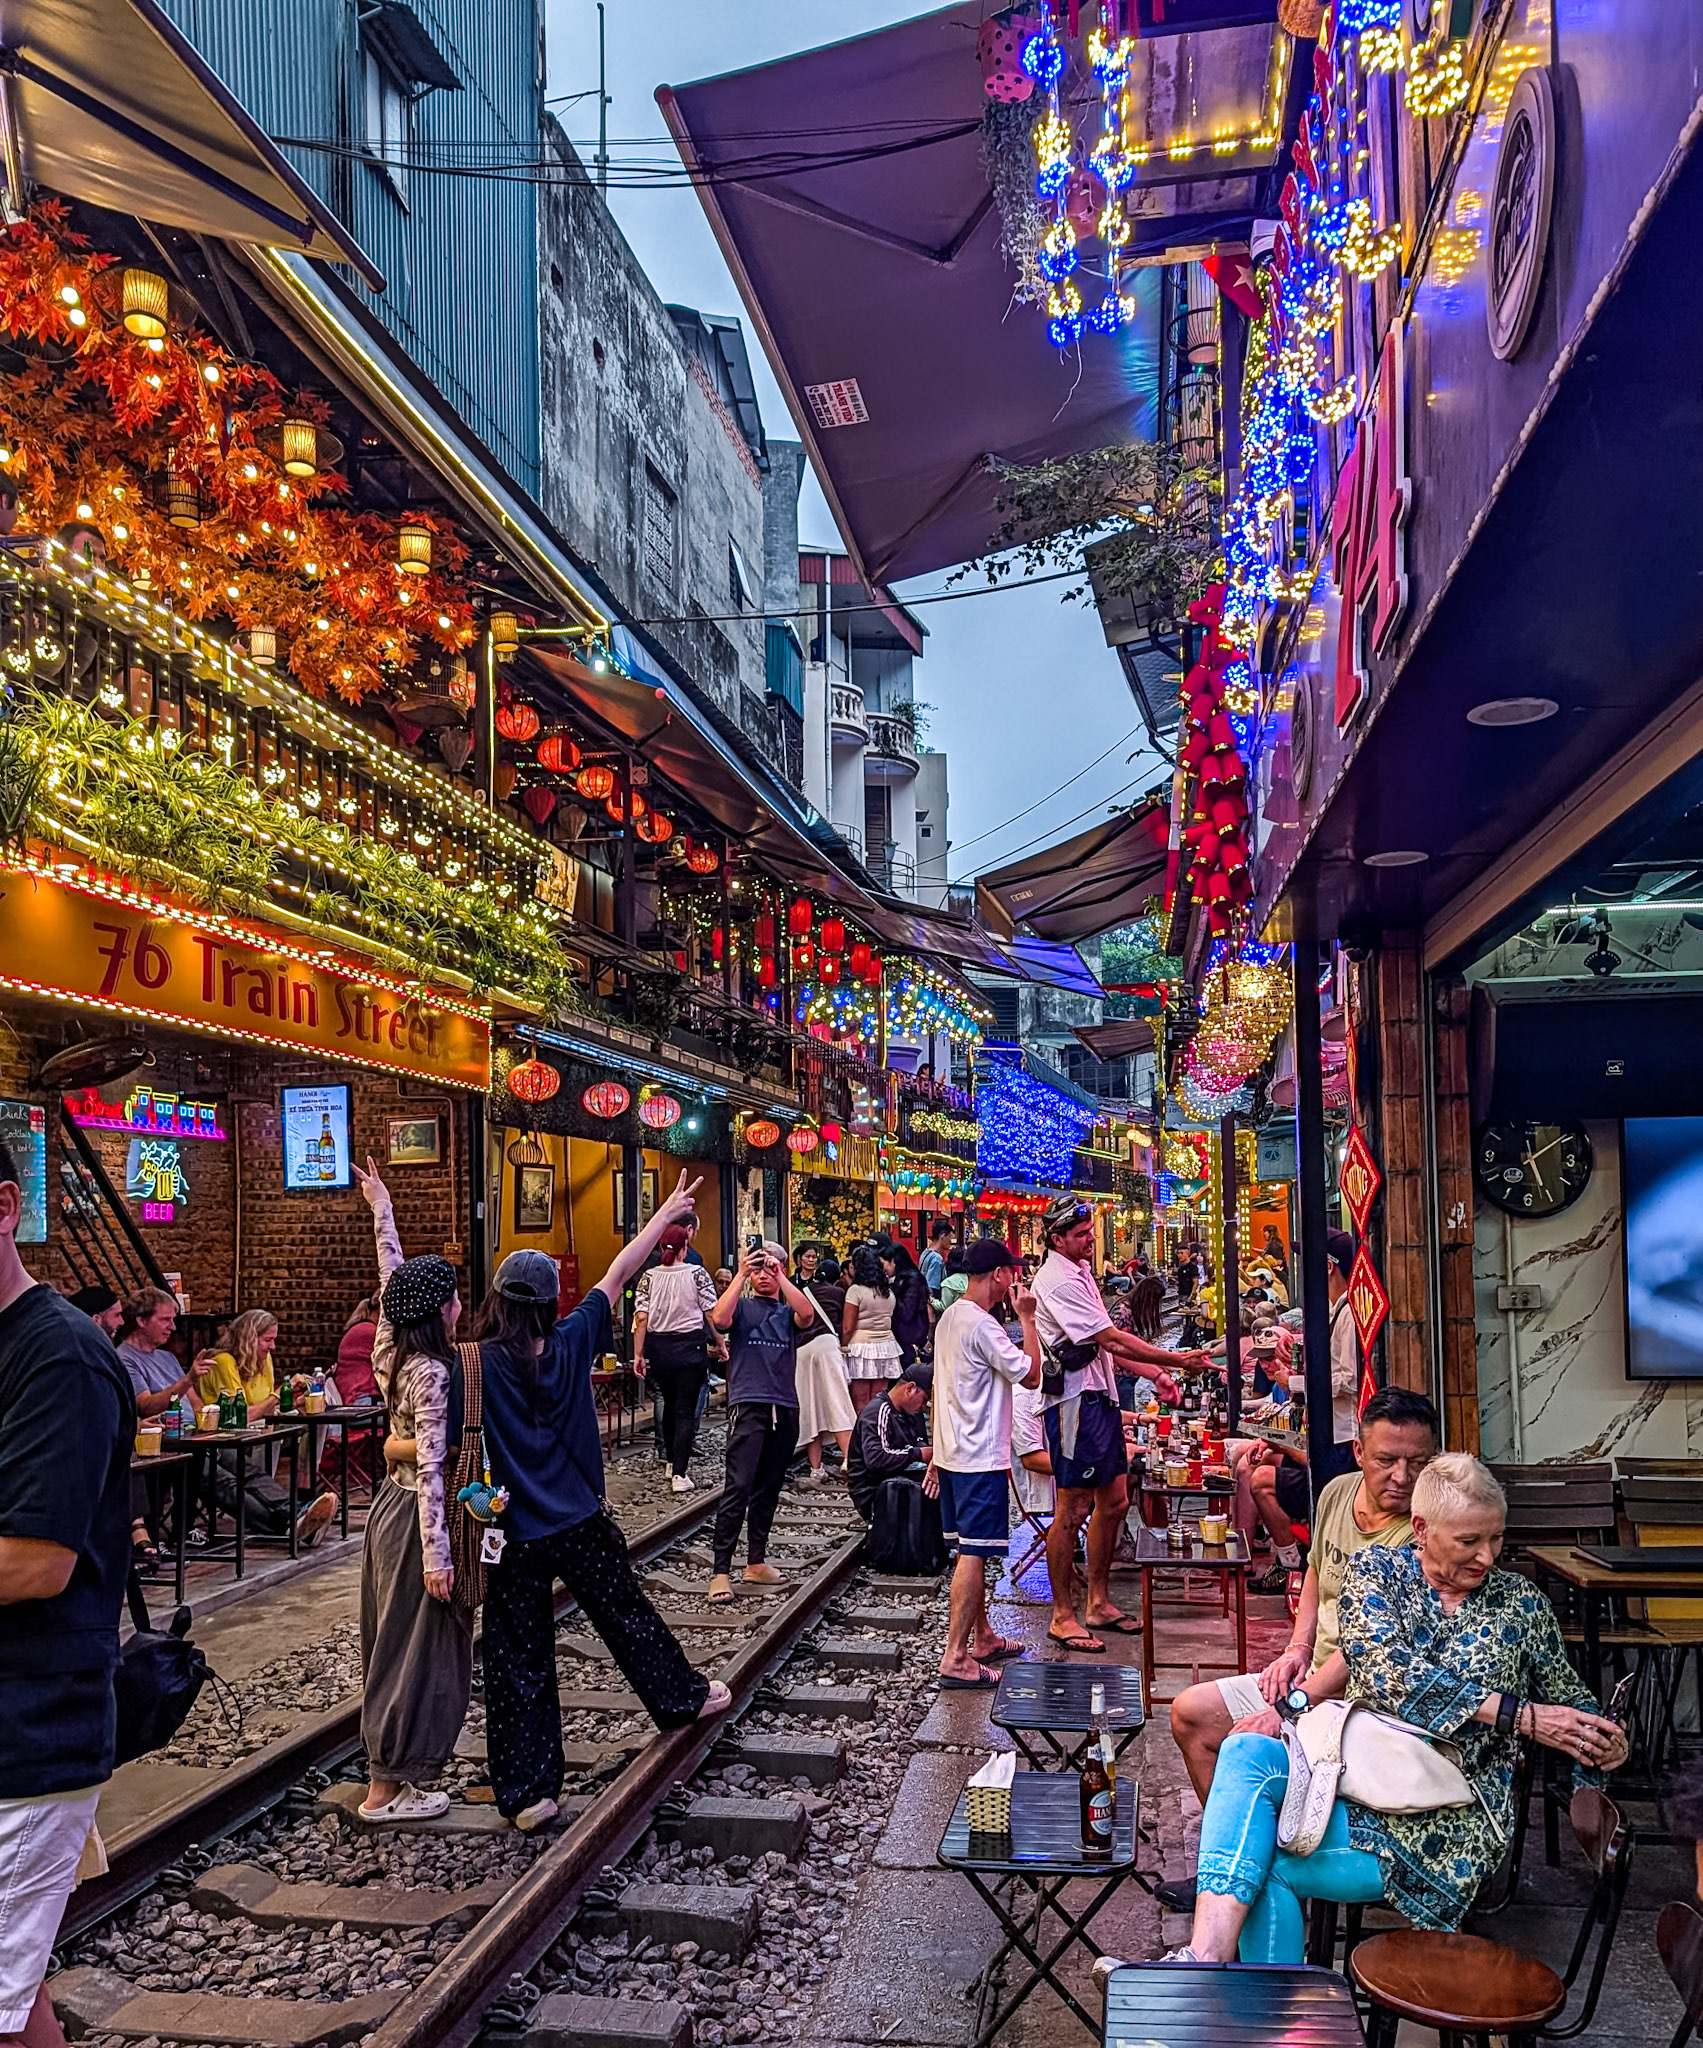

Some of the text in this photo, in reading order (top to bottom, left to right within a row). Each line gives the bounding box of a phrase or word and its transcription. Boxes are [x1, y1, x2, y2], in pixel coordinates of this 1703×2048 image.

[94, 921, 444, 1060] 76 Train Street
[1485, 1150, 1495, 1162] 9
[1566, 1154, 1576, 1168] 3
[1523, 1193, 1533, 1207] 6
[144, 1203, 174, 1221] BEER
